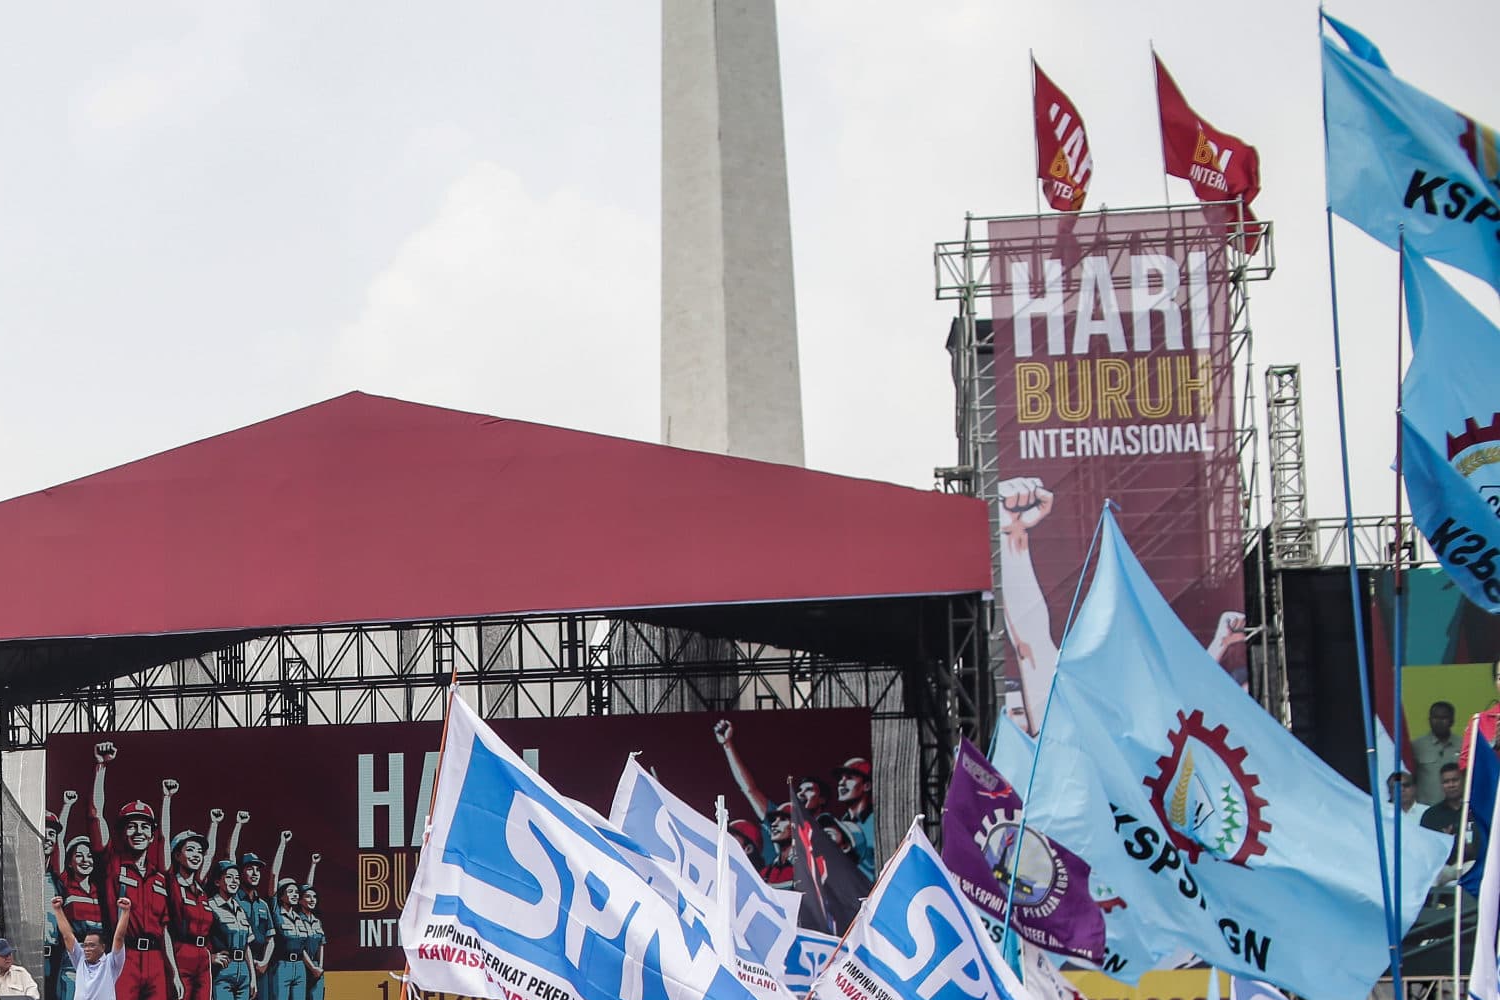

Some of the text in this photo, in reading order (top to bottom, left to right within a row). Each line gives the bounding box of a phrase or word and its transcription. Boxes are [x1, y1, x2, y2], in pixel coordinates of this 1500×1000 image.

[1403, 168, 1500, 244] KSP
[1011, 251, 1210, 357] HARI
[1016, 354, 1213, 423] BURUH
[1020, 422, 1214, 459] INTERNASIONAL
[418, 944, 493, 982] KAWAS
[424, 924, 481, 950] PIMPINAN
[481, 949, 527, 987] SERIKAT
[1217, 918, 1272, 972] GN
[842, 961, 876, 995] PIMPINAN
